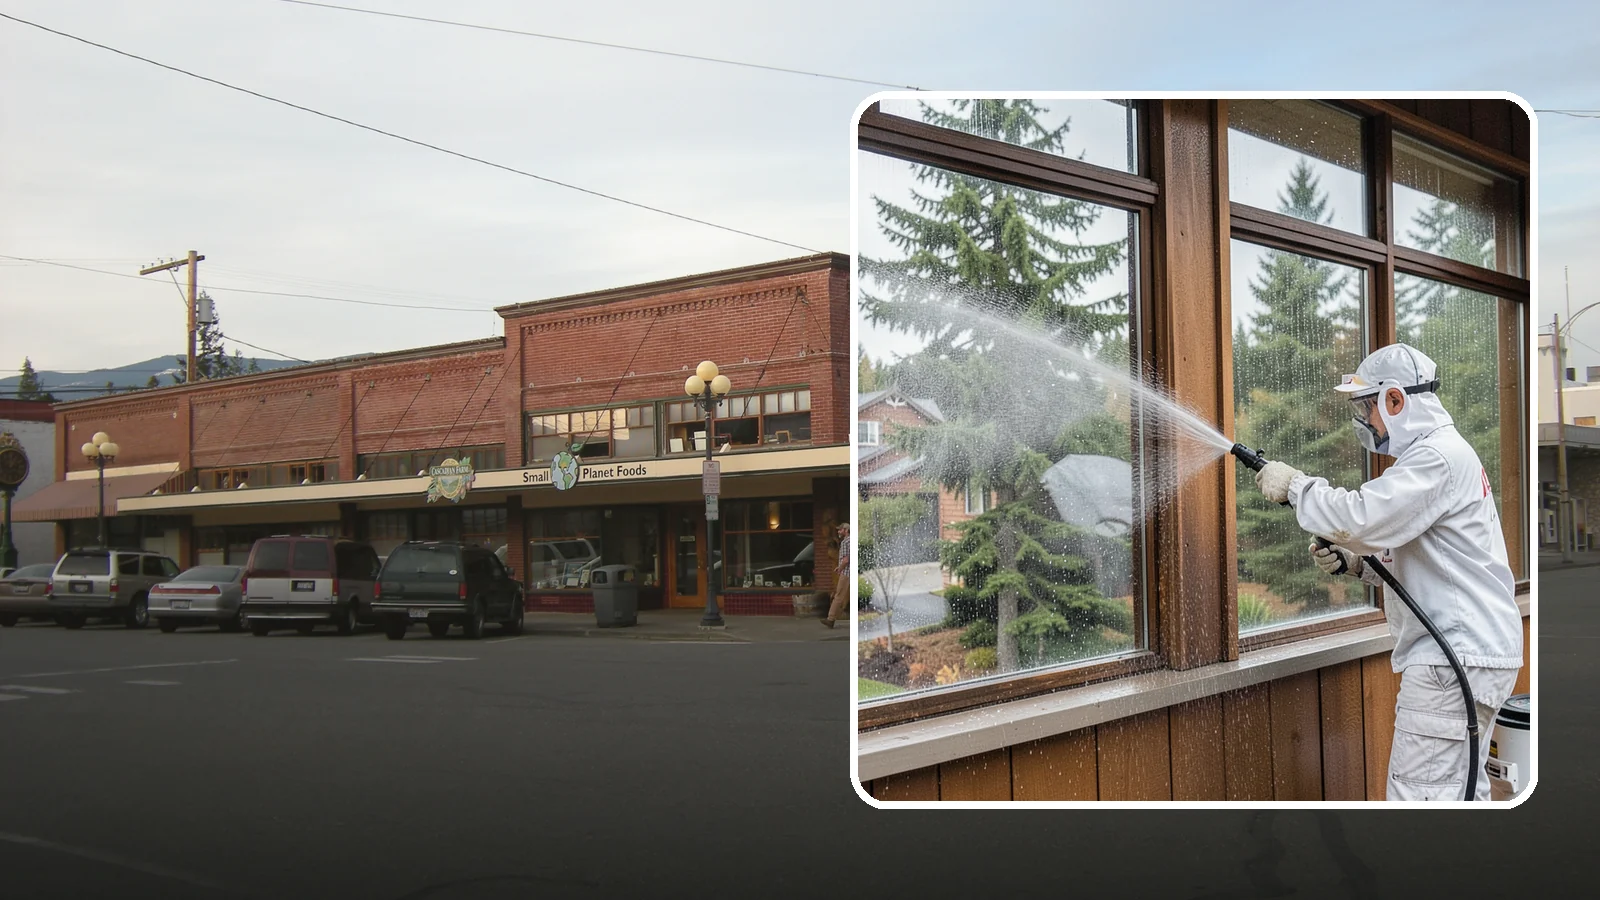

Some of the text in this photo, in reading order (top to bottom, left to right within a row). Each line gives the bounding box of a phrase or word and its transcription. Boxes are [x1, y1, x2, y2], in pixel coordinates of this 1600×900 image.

[522, 464, 647, 483] Small Planet Foods
